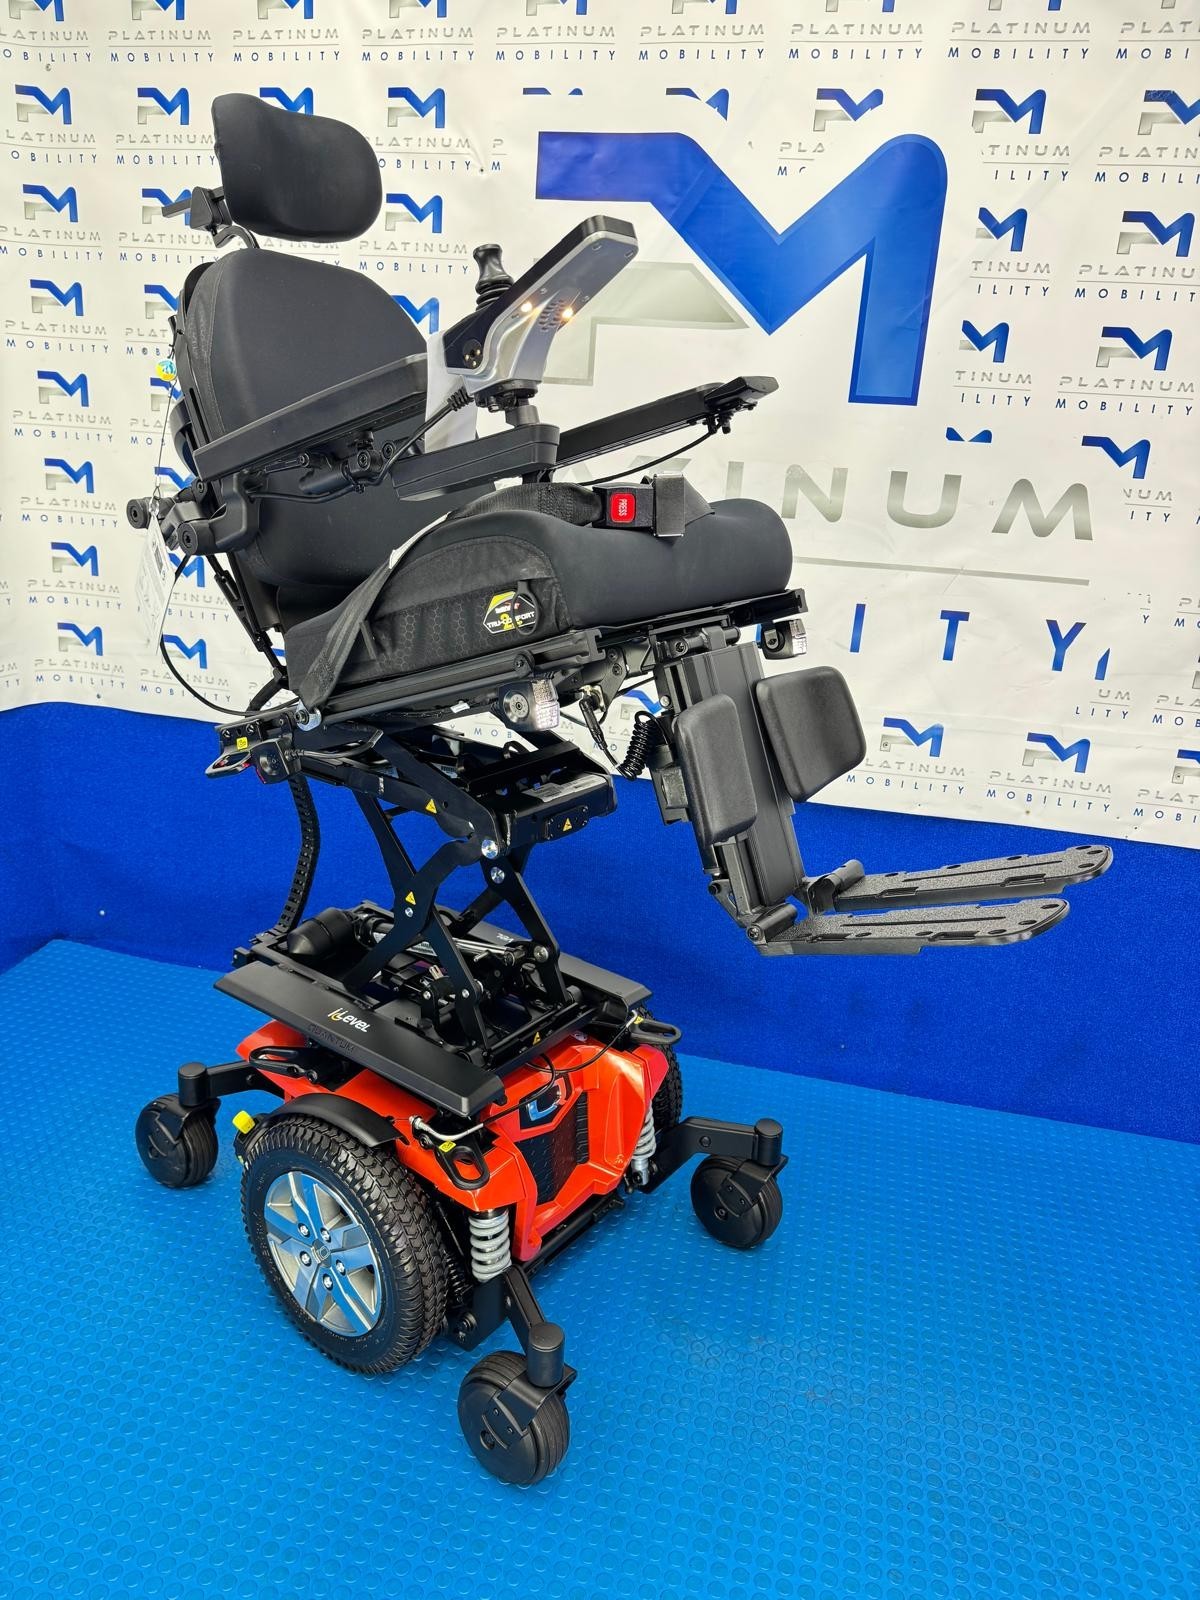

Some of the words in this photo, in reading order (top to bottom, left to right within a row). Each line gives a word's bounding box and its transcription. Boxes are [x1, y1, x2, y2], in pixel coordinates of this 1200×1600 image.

[233, 29, 339, 40] PLATINUM
[362, 27, 474, 39] PLATINUM
[496, 26, 615, 38] PLATINUM
[640, 24, 765, 37] PLATINUM
[791, 23, 923, 36] PLATINUM
[951, 22, 1091, 34] PLATINUM
[108, 30, 211, 41] PLATINUM
[111, 53, 214, 62] MOBILITY
[234, 51, 340, 62] MOBILITY
[362, 51, 474, 61] MOBILITY
[496, 50, 615, 61] MOBILITY
[638, 49, 764, 60] MOBILITY
[789, 48, 922, 60] MOBILITY
[948, 47, 1088, 59] MOBILITY
[115, 133, 214, 144] PLATINUM
[116, 155, 215, 165] MOBILITY
[359, 240, 468, 254] PLATINUM
[359, 261, 468, 274] MOBILITY
[5, 320, 107, 335] PLATINUM
[7, 338, 109, 353] MOBILITY
[1059, 376, 1194, 392] PLATINUM
[1056, 398, 1192, 416] MOBILITY
[13, 410, 111, 424] PLATINUM
[15, 428, 113, 442] MOBILITY
[20, 497, 116, 511] PLATINUM
[618, 498, 628, 516] PRESS
[22, 514, 118, 528] MOBILITY
[27, 579, 120, 594] PLATINUM
[29, 596, 122, 610] MOBILITY
[34, 658, 124, 673] PLATINUM
[36, 674, 125, 689] MOBILITY
[140, 668, 229, 687] PLAINUM
[140, 684, 231, 702] MOBIITY
[846, 774, 964, 794] MOBILITY
[989, 770, 1112, 793] PLATINUM
[986, 789, 1110, 812] MOBILITY
